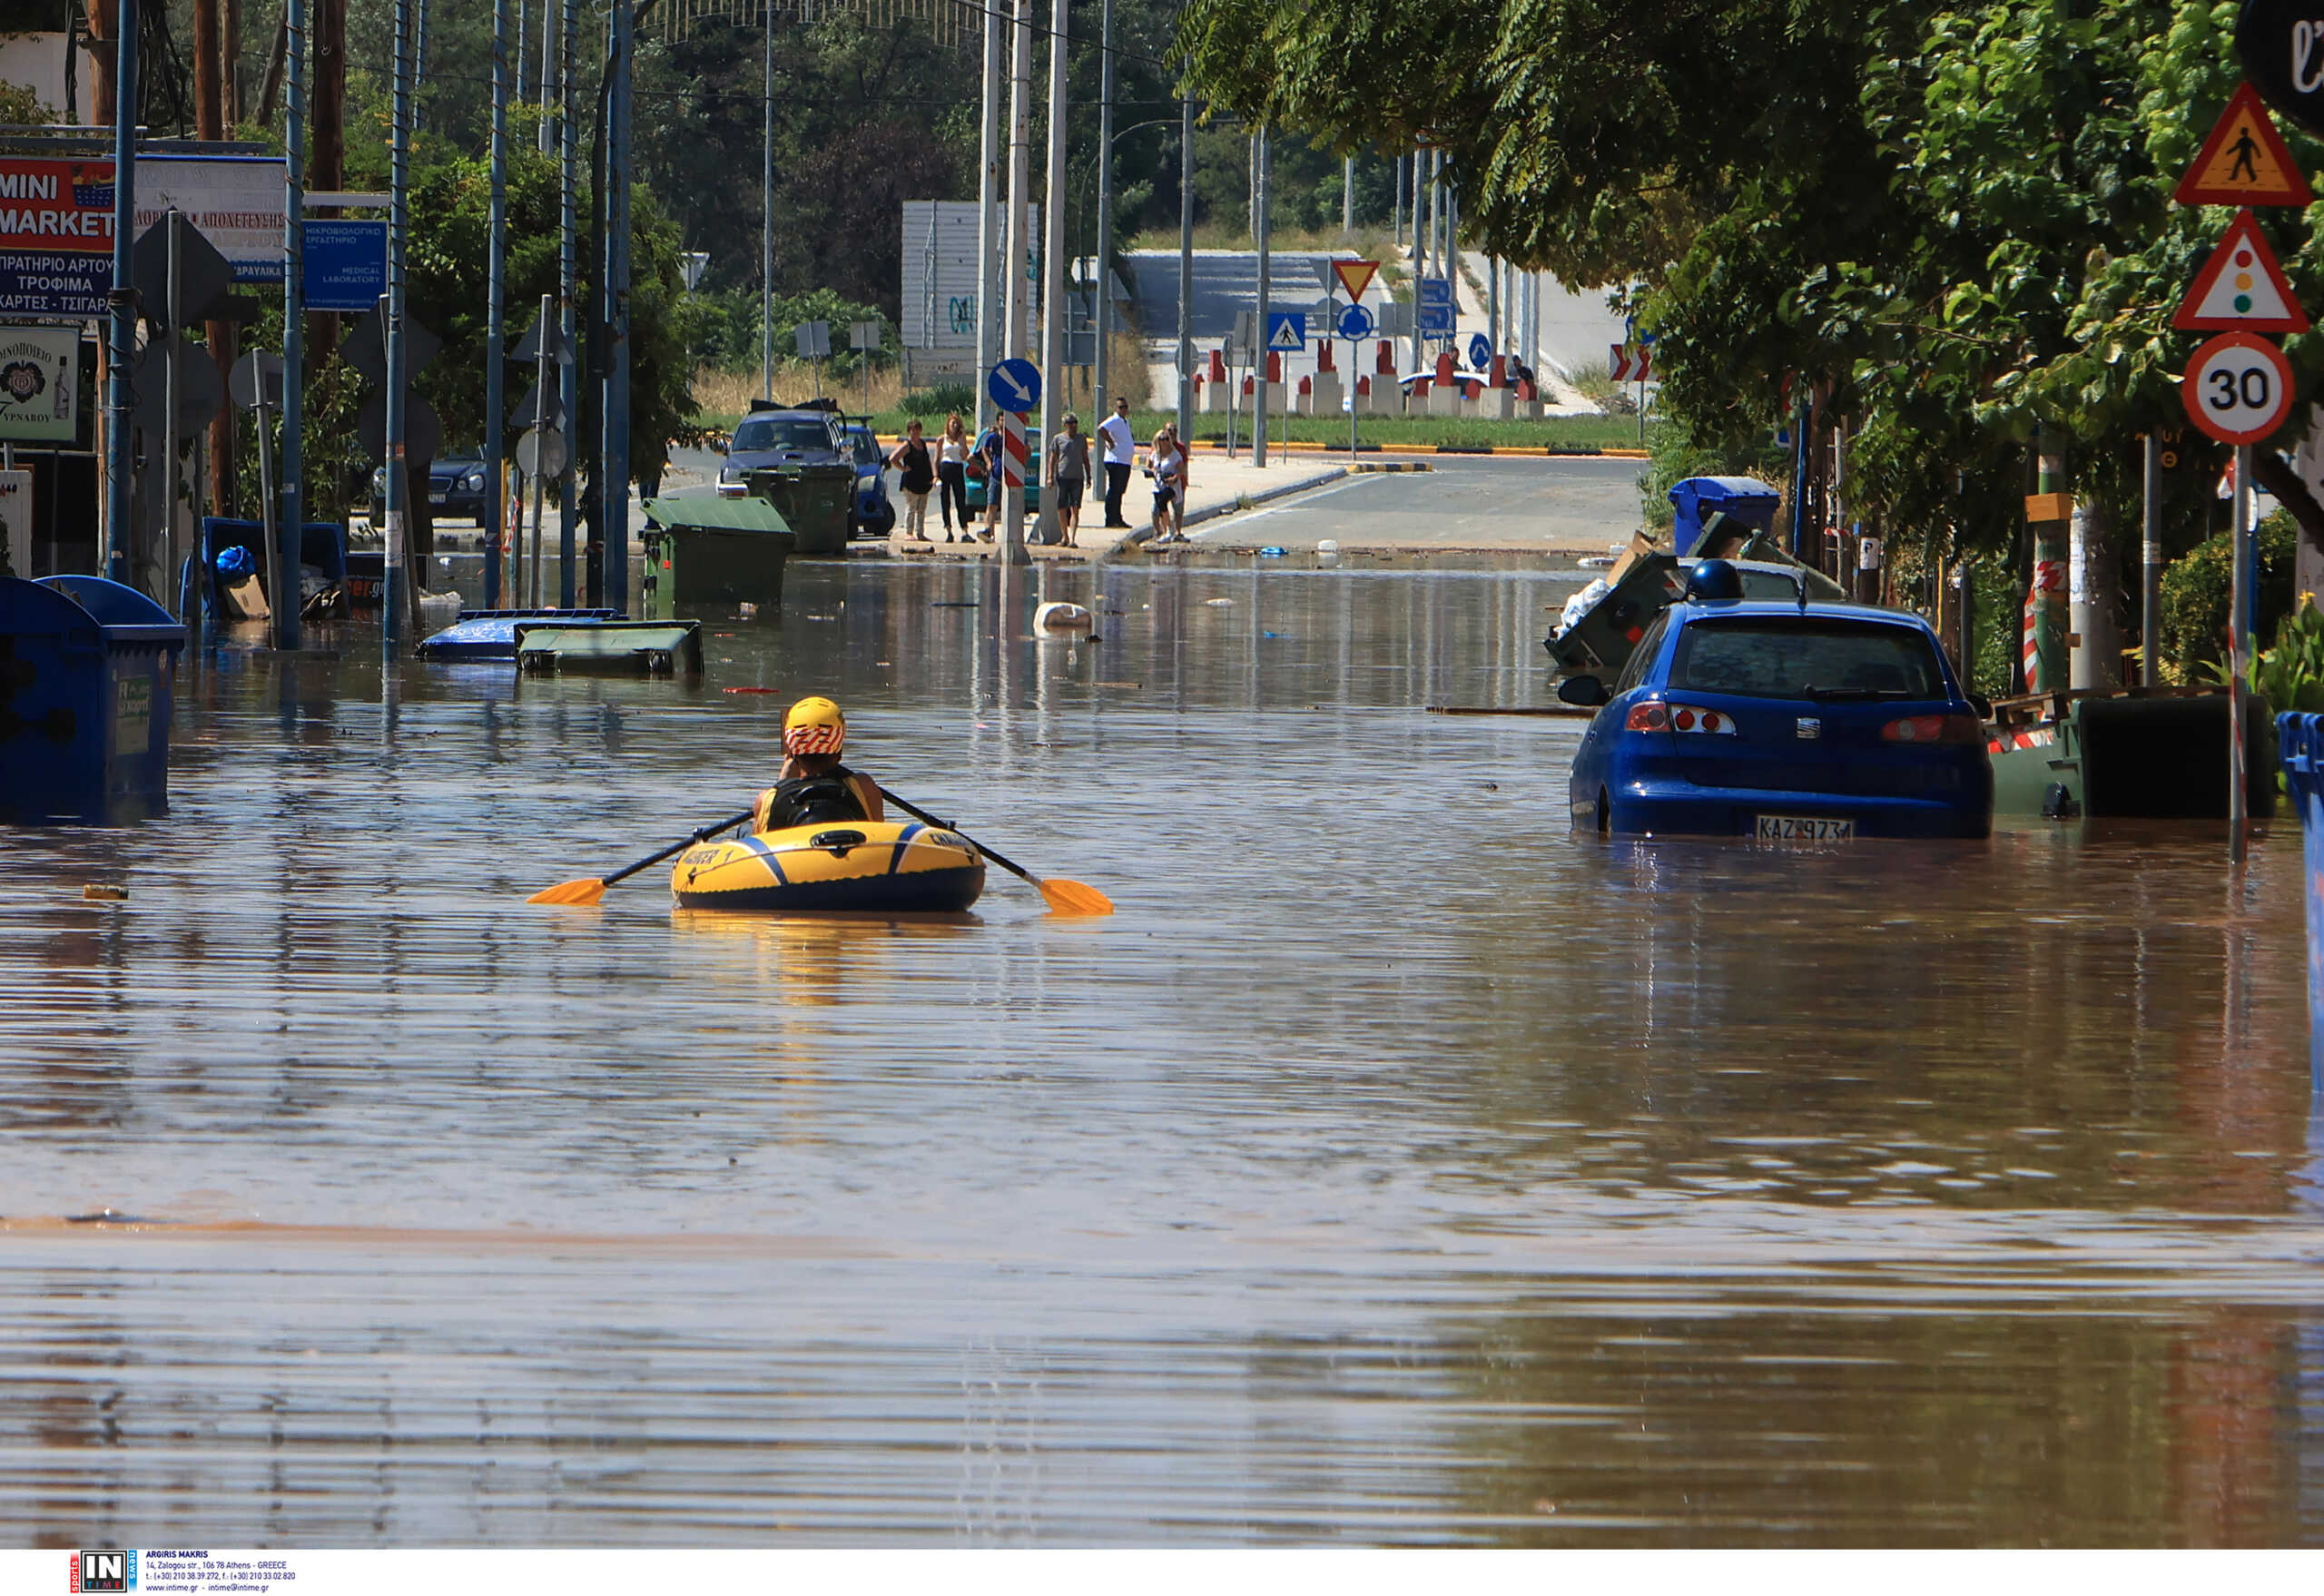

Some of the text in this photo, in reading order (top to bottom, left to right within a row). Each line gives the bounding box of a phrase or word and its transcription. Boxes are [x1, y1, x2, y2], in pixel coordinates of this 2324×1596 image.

[0, 173, 58, 200] MINI
[0, 209, 115, 237] MARKET
[305, 236, 357, 244] ΕΡΓΑΣΤΗΡΙΟ
[0, 256, 114, 273] ΠΡΑΤΗΡΙΟ ΑΡΤΟΥ
[233, 266, 281, 276] ΔΡΑΥΛΙΚΑ
[341, 267, 380, 275] MEDICAL
[17, 275, 94, 291] ΤΡΟΦΙΜΑ
[322, 275, 380, 283] LABORATORY
[2209, 368, 2269, 410] 30
[1759, 817, 1794, 838] KAZ
